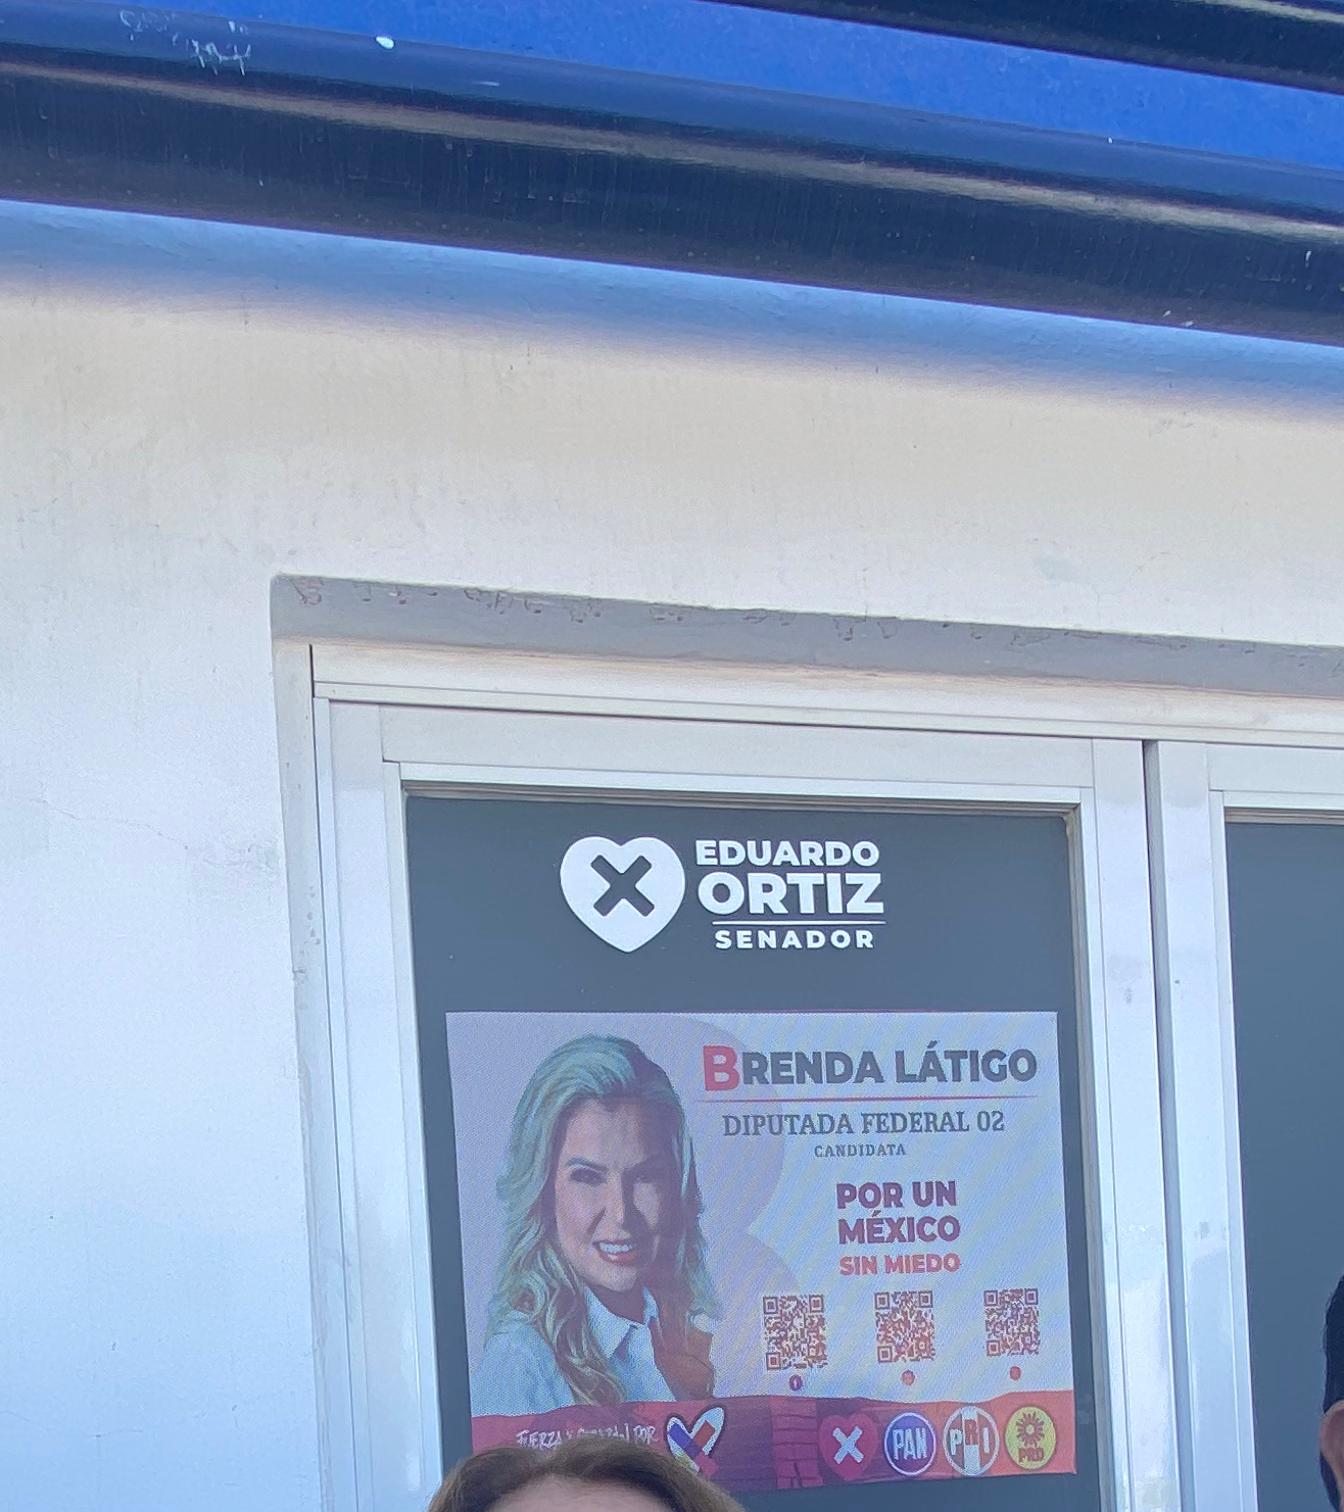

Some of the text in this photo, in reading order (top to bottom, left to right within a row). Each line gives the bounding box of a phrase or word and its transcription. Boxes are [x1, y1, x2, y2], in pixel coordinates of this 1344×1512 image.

[695, 839, 880, 867] EDUARDO
[698, 871, 885, 915] ORTIZ
[714, 929, 874, 949] SENADOR
[702, 1039, 1038, 1092] BRENDA LÁTIGO
[722, 1110, 1006, 1137] DIPUTADA FEDERAL 02
[814, 1143, 907, 1158] CANDIDATA
[836, 1180, 957, 1210] POR UN
[838, 1209, 961, 1245] MÉXICO
[839, 1252, 961, 1276] SIN MIEDO
[892, 1427, 928, 1461] PAN
[949, 1418, 990, 1456] PRI
